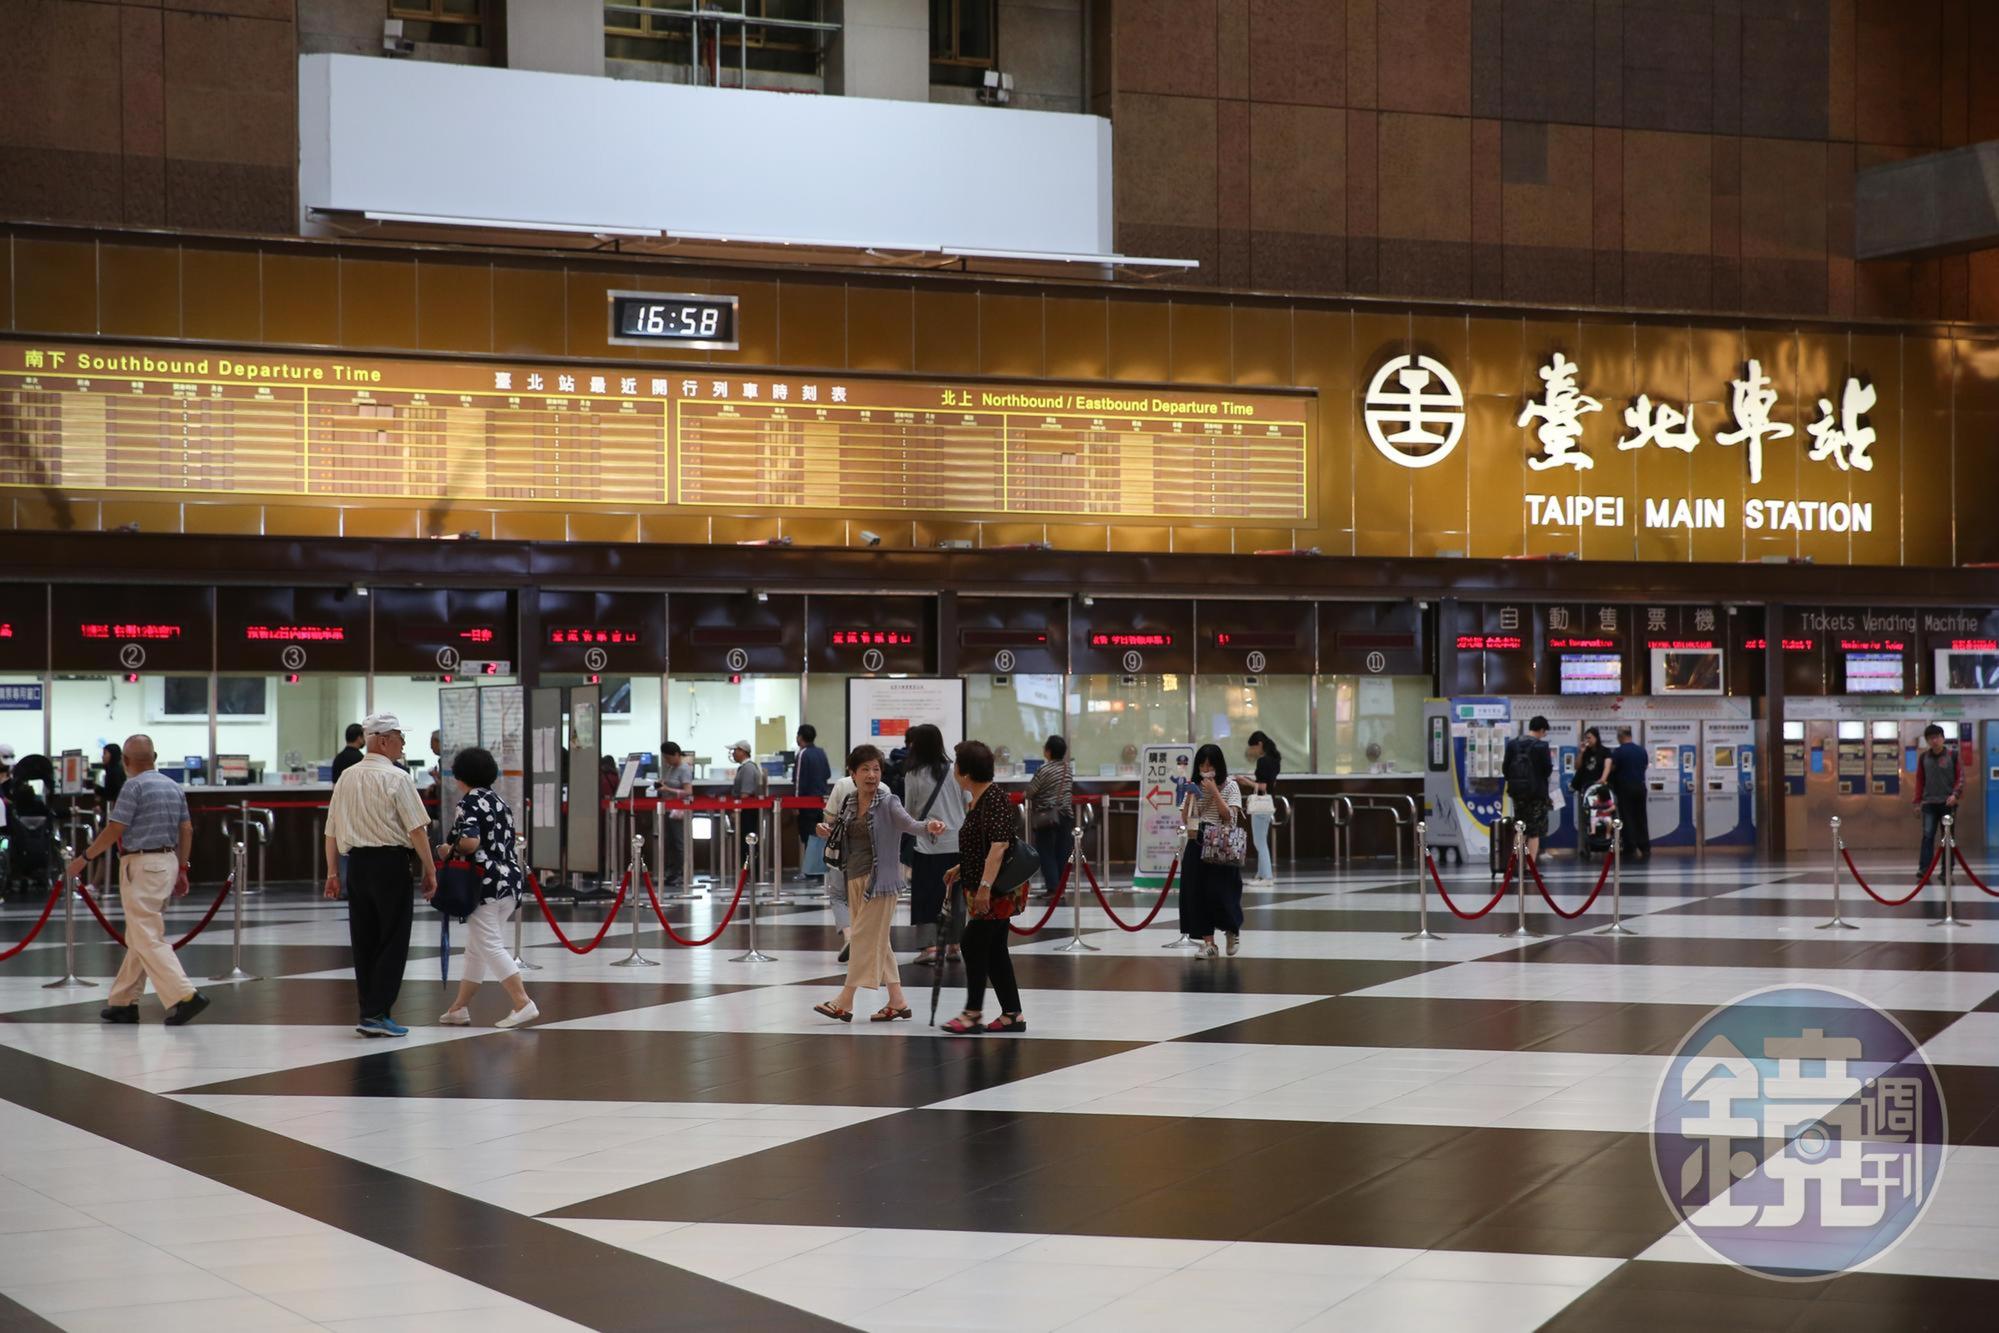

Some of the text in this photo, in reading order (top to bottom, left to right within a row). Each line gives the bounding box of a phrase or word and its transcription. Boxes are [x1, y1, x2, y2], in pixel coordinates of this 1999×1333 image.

[636, 306, 719, 335] 16:58
[25, 350, 382, 383] 南下 Southbound Departure Time
[941, 389, 1254, 417] 北上 Northbound / Eastbound Departure Time
[1517, 352, 1878, 485] 臺北車站
[1525, 495, 1872, 533] TAIPEI MAIN STATION
[1500, 606, 1715, 632] 自動售票機
[1802, 613, 1978, 633] Tickets Vending Machine
[486, 662, 498, 676] 2
[1147, 765, 1166, 777] 入口
